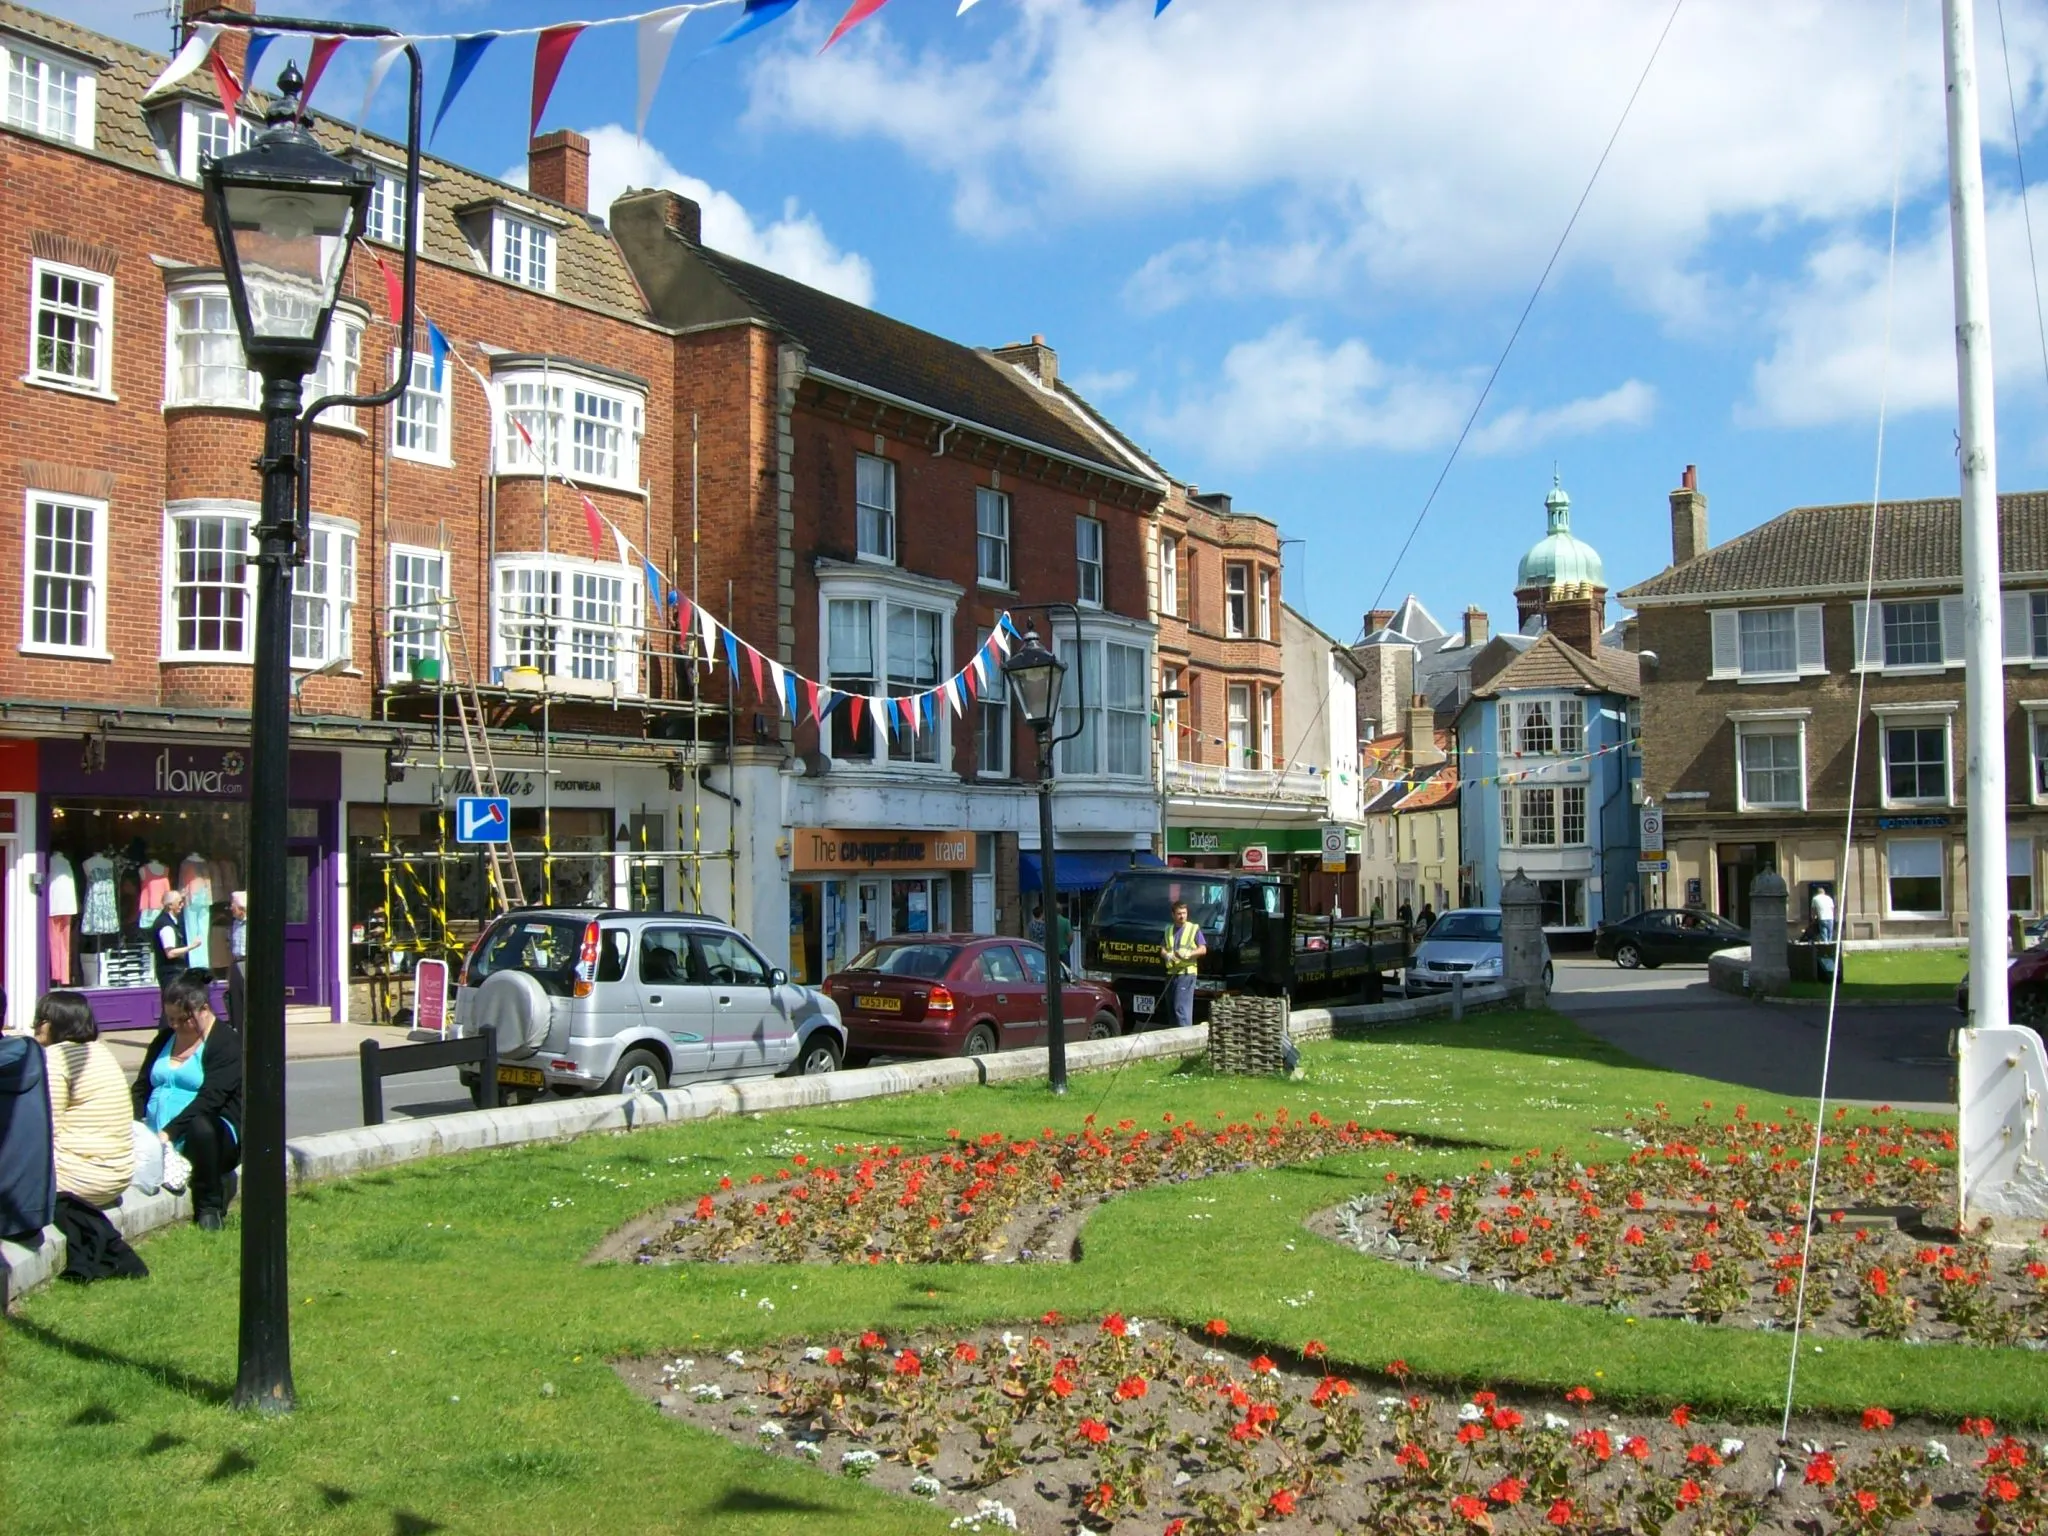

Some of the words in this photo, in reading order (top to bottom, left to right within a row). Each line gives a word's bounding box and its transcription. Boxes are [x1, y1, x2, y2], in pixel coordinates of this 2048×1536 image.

[554, 780, 601, 792] FOOTWEAR
[811, 835, 836, 862] The
[934, 836, 967, 862] travel
[1099, 940, 1106, 949] H
[1110, 942, 1133, 952] TECH
